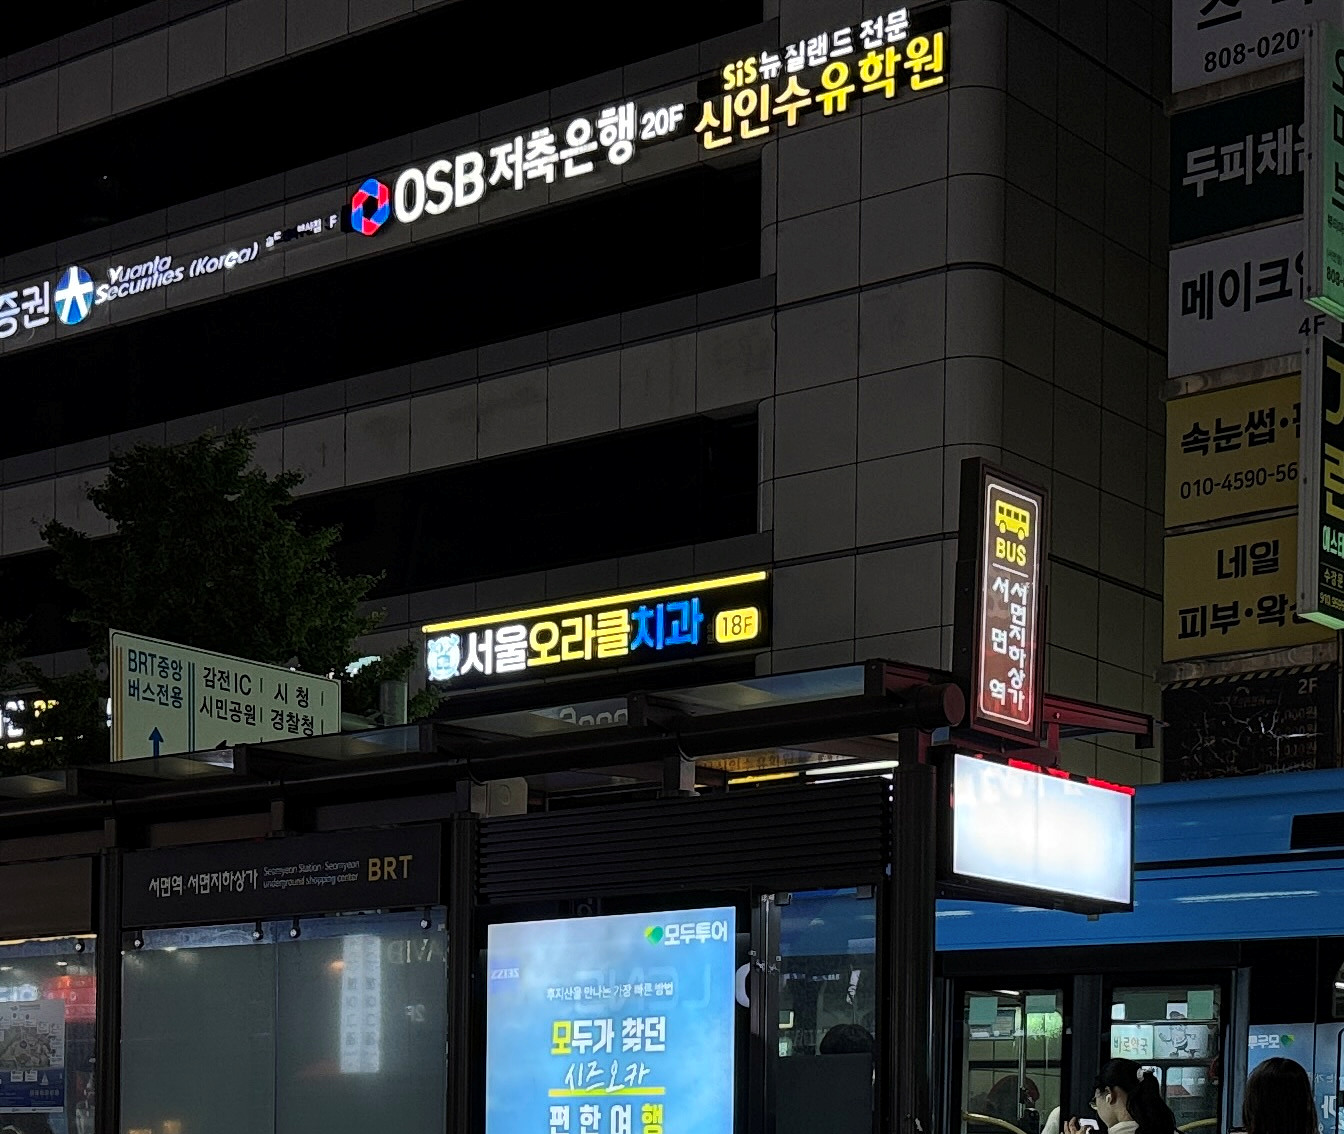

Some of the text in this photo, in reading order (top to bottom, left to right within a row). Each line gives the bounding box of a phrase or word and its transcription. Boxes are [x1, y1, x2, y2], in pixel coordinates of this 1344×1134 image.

[859, 7, 910, 44] 전문
[694, 30, 946, 150] 신인수유학원
[640, 104, 685, 141] 20F
[94, 241, 259, 305] Securities (Korea)
[108, 254, 172, 285] Yuanta
[1182, 250, 1306, 322] 메이크
[1299, 313, 1327, 338] 4F
[994, 536, 1027, 566] BUS
[1216, 538, 1281, 581] 네일
[459, 597, 755, 676] 서울오라클치과 18F
[1007, 581, 1029, 712] 서면지하상가
[1297, 676, 1319, 695] 2F
[127, 677, 315, 737] 버스전용 시민공원 경찰청
[367, 854, 414, 882] BRT
[664, 920, 729, 946] 모두투어
[551, 1016, 666, 1055] 모두가 찾던
[1113, 1035, 1149, 1055] 바로약국
[564, 1059, 651, 1093] 시즈오카
